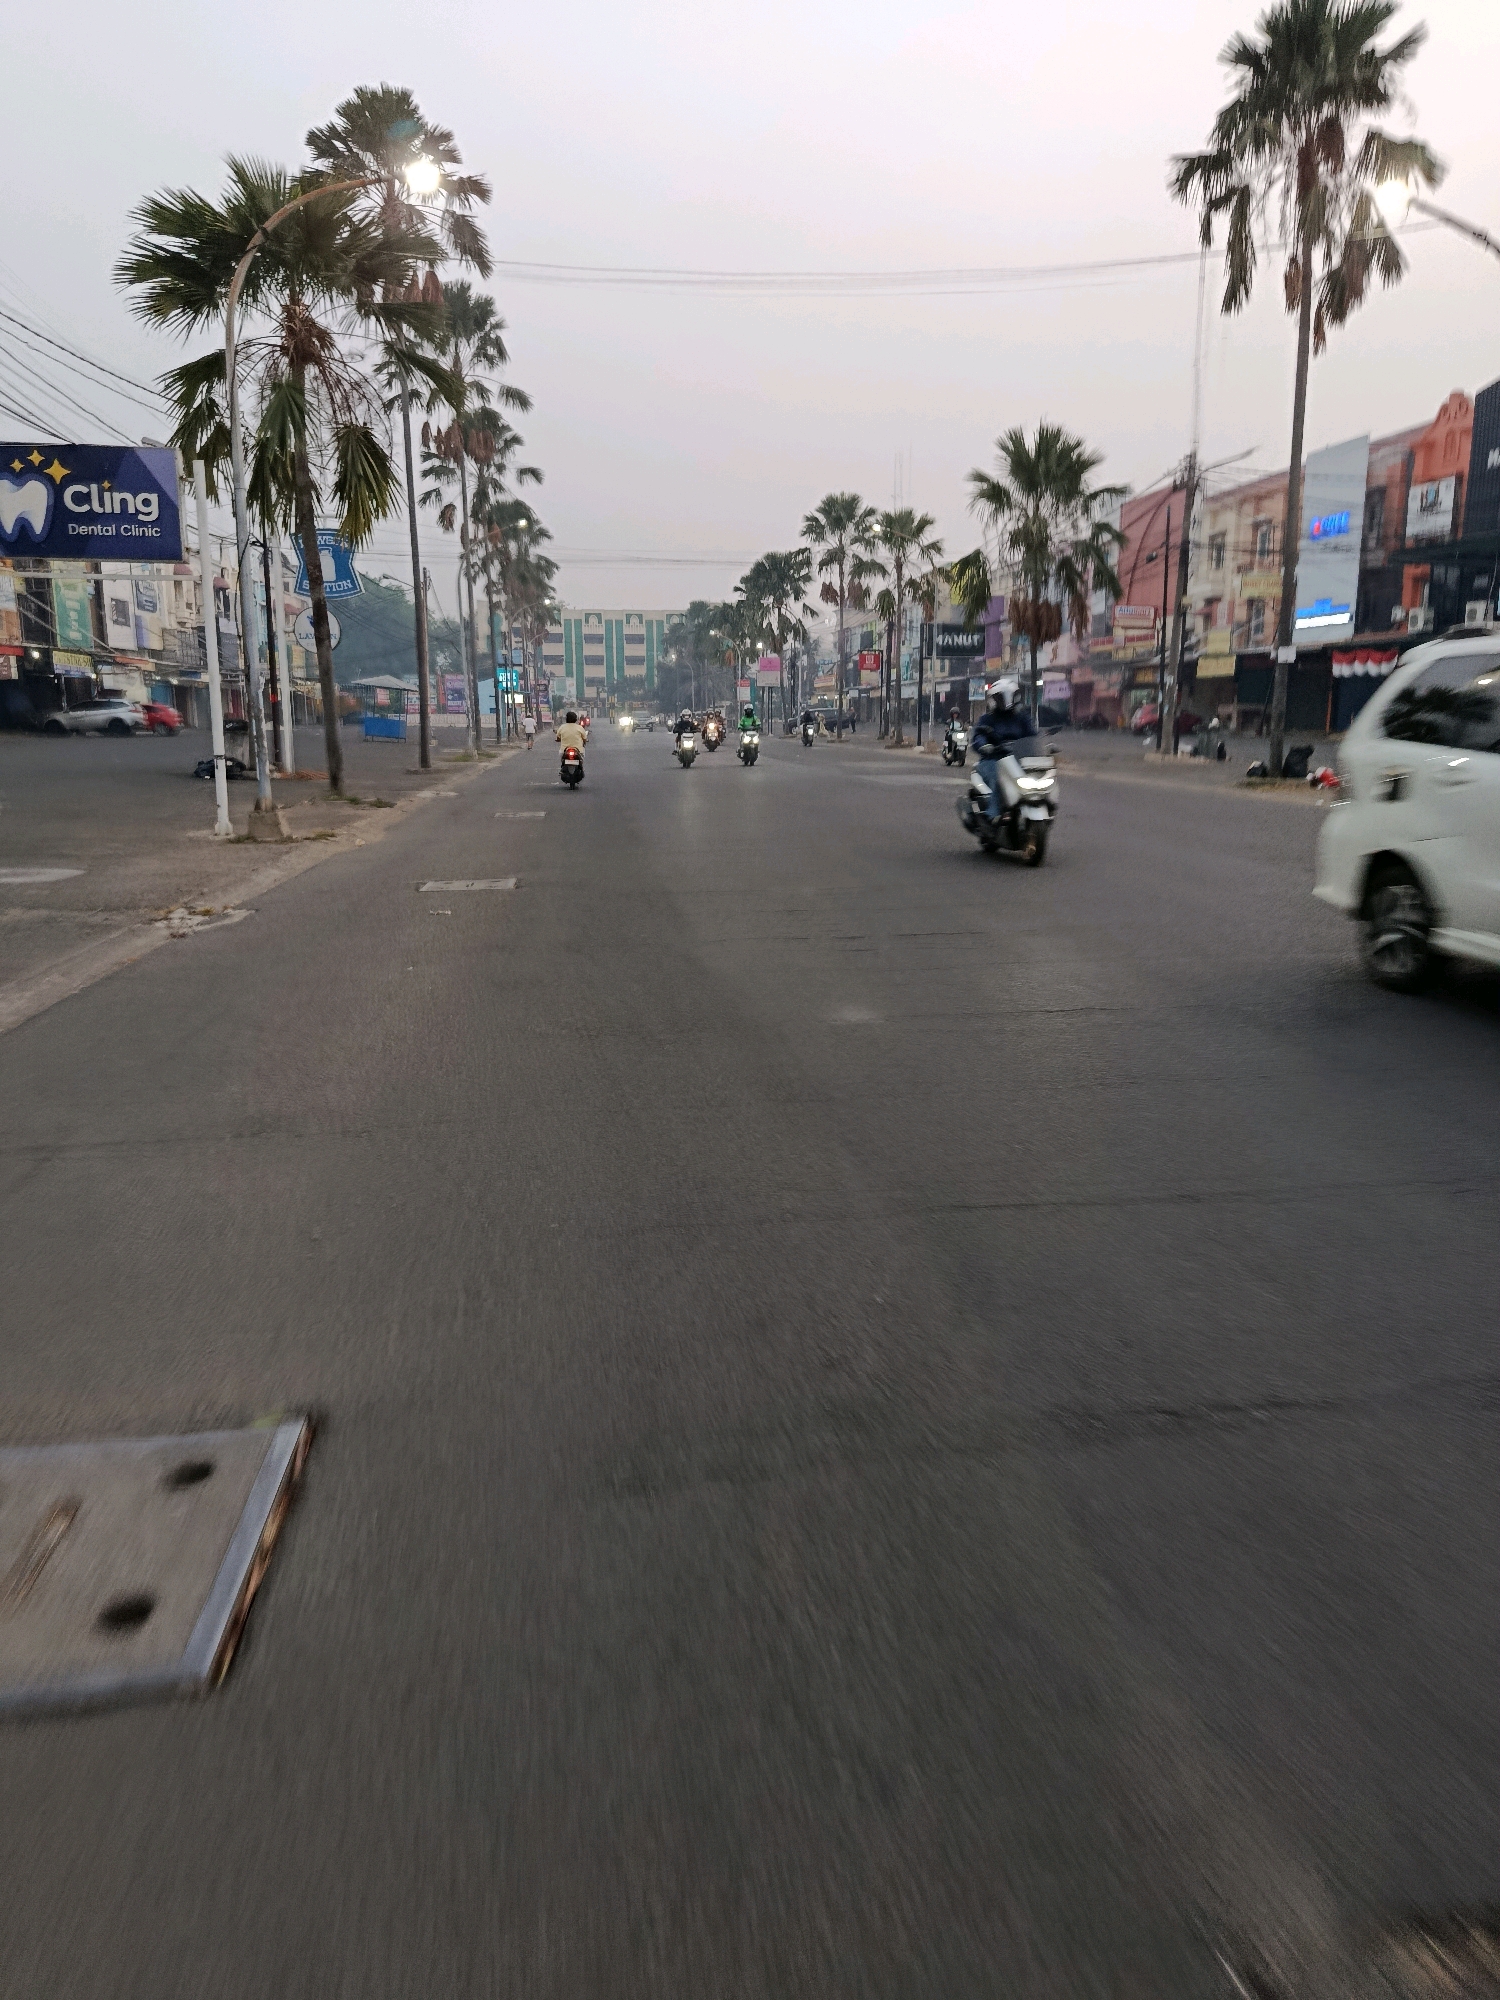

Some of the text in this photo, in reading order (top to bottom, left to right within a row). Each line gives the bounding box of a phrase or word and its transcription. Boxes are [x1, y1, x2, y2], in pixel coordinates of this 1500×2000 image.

[63, 482, 159, 521] Cling
[68, 523, 161, 537] Dental Clinic
[302, 579, 354, 592] STION
